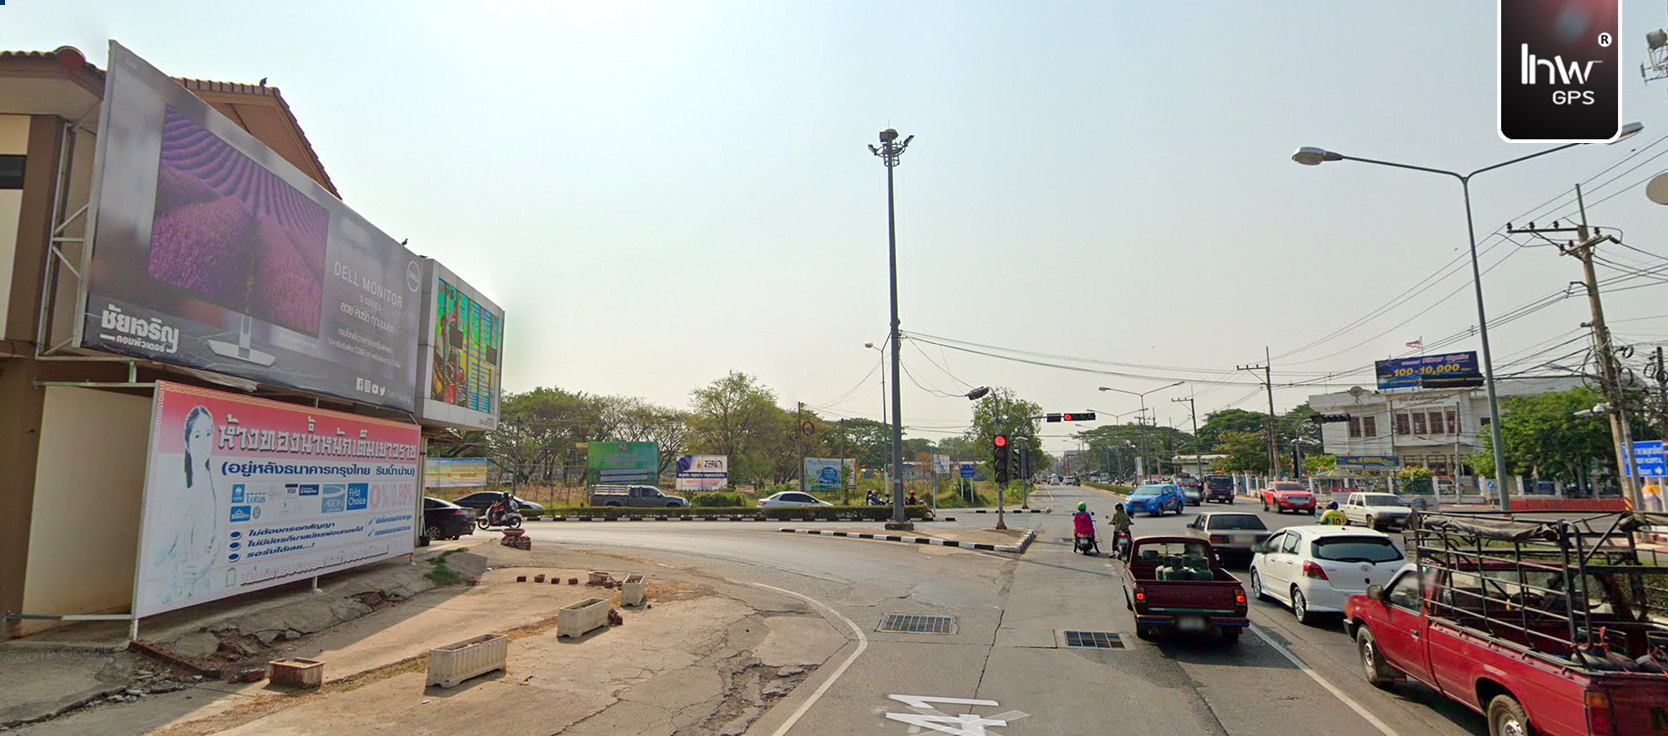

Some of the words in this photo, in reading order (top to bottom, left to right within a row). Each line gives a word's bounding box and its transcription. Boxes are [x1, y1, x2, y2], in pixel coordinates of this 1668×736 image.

[334, 261, 359, 287] DELL
[362, 277, 403, 308] MONITOR
[101, 303, 180, 353] ชัยเจริญ
[115, 335, 167, 354] คอมพิวเตอร์
[1394, 364, 1460, 377] 100-10,000
[217, 414, 417, 460] ห้างทองน้ำหนักเต็มเยาวราช
[221, 461, 371, 478] (อยู่หลังธนาคารกรุงไทย
[376, 463, 415, 477] ริมน้ำน่าน)
[246, 495, 266, 504] Lotus
[349, 486, 361, 497] First
[348, 496, 366, 506] Choice
[247, 521, 336, 538] ไม่ต้องกรอกสัญญา
